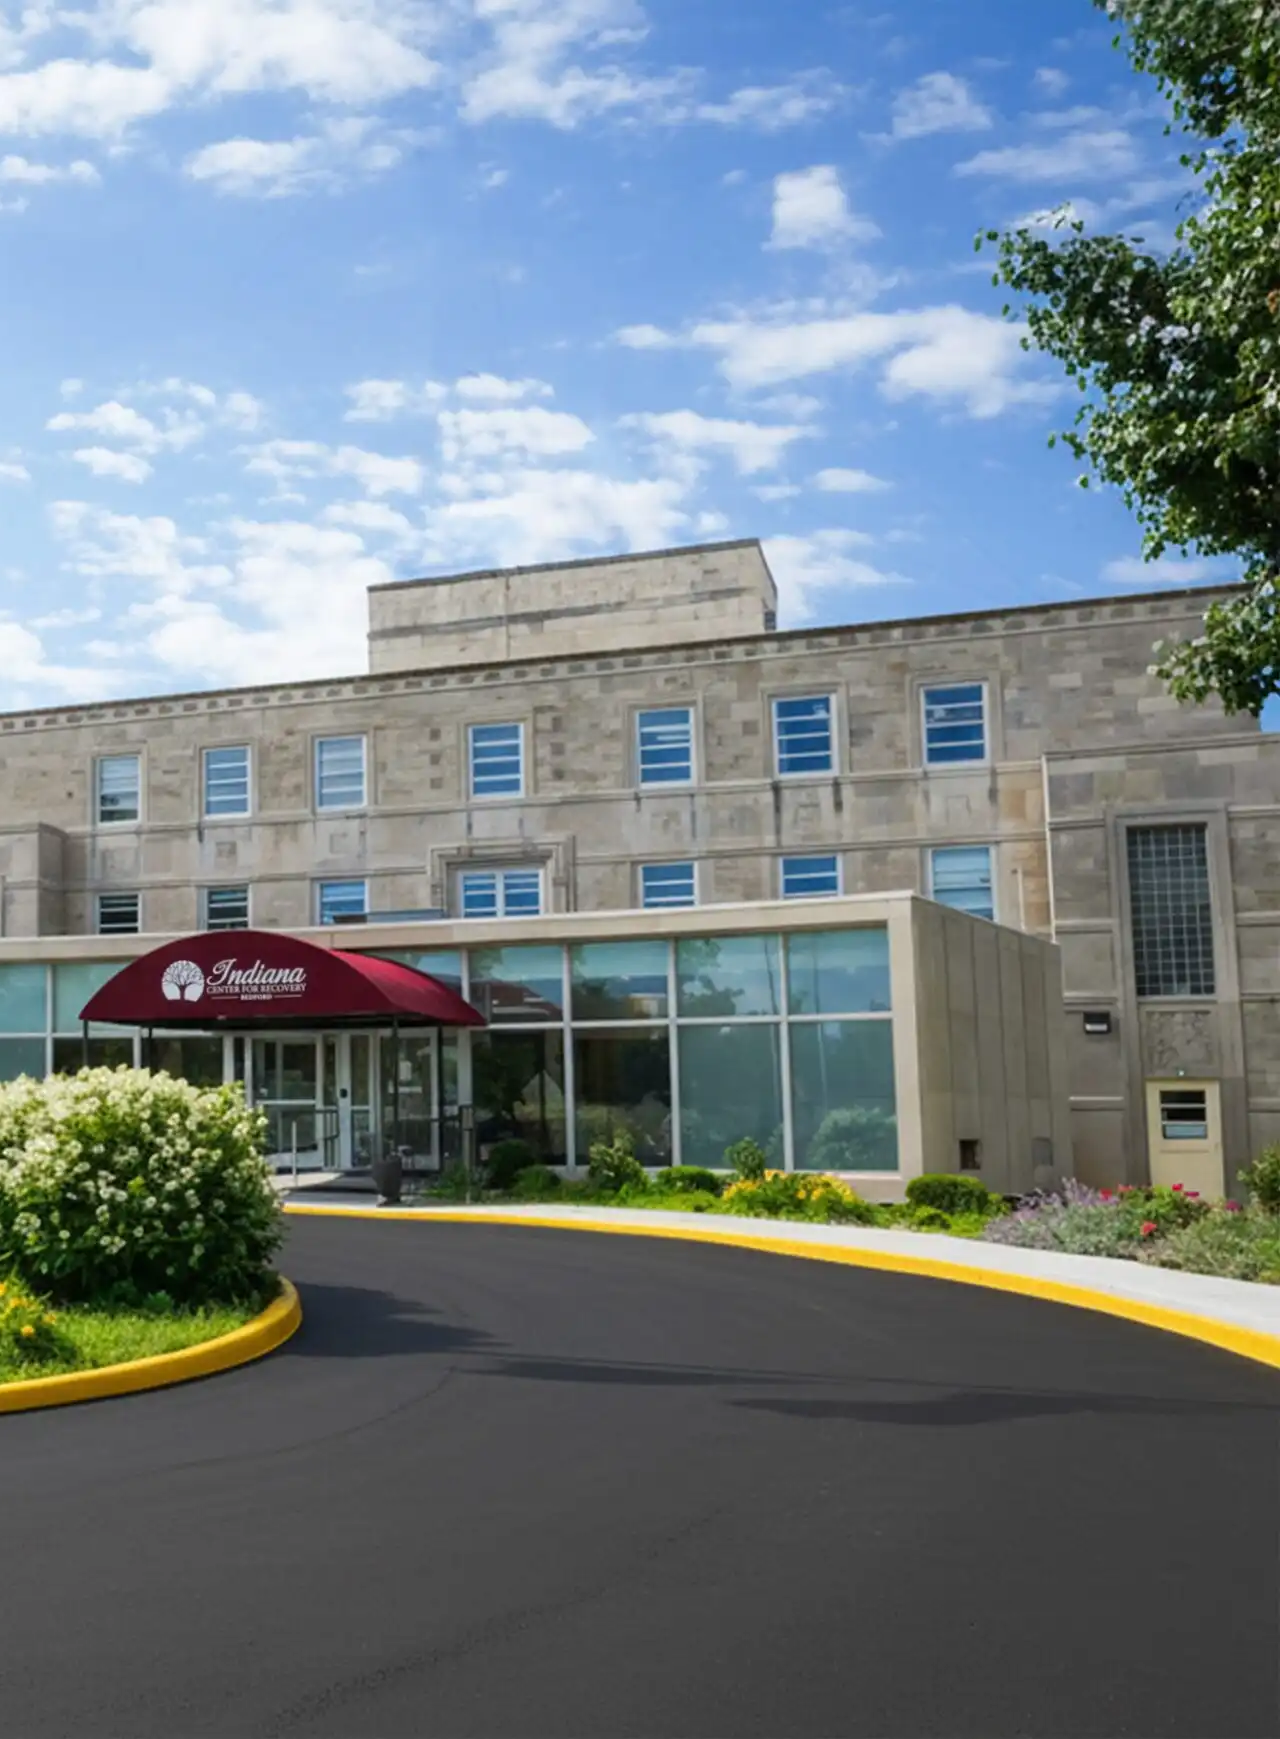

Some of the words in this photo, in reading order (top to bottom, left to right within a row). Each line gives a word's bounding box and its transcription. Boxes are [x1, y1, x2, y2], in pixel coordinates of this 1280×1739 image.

[206, 958, 306, 986] Indiana
[206, 985, 240, 994] CENTER
[242, 985, 259, 993] FOR
[261, 984, 306, 993] RECOVERY
